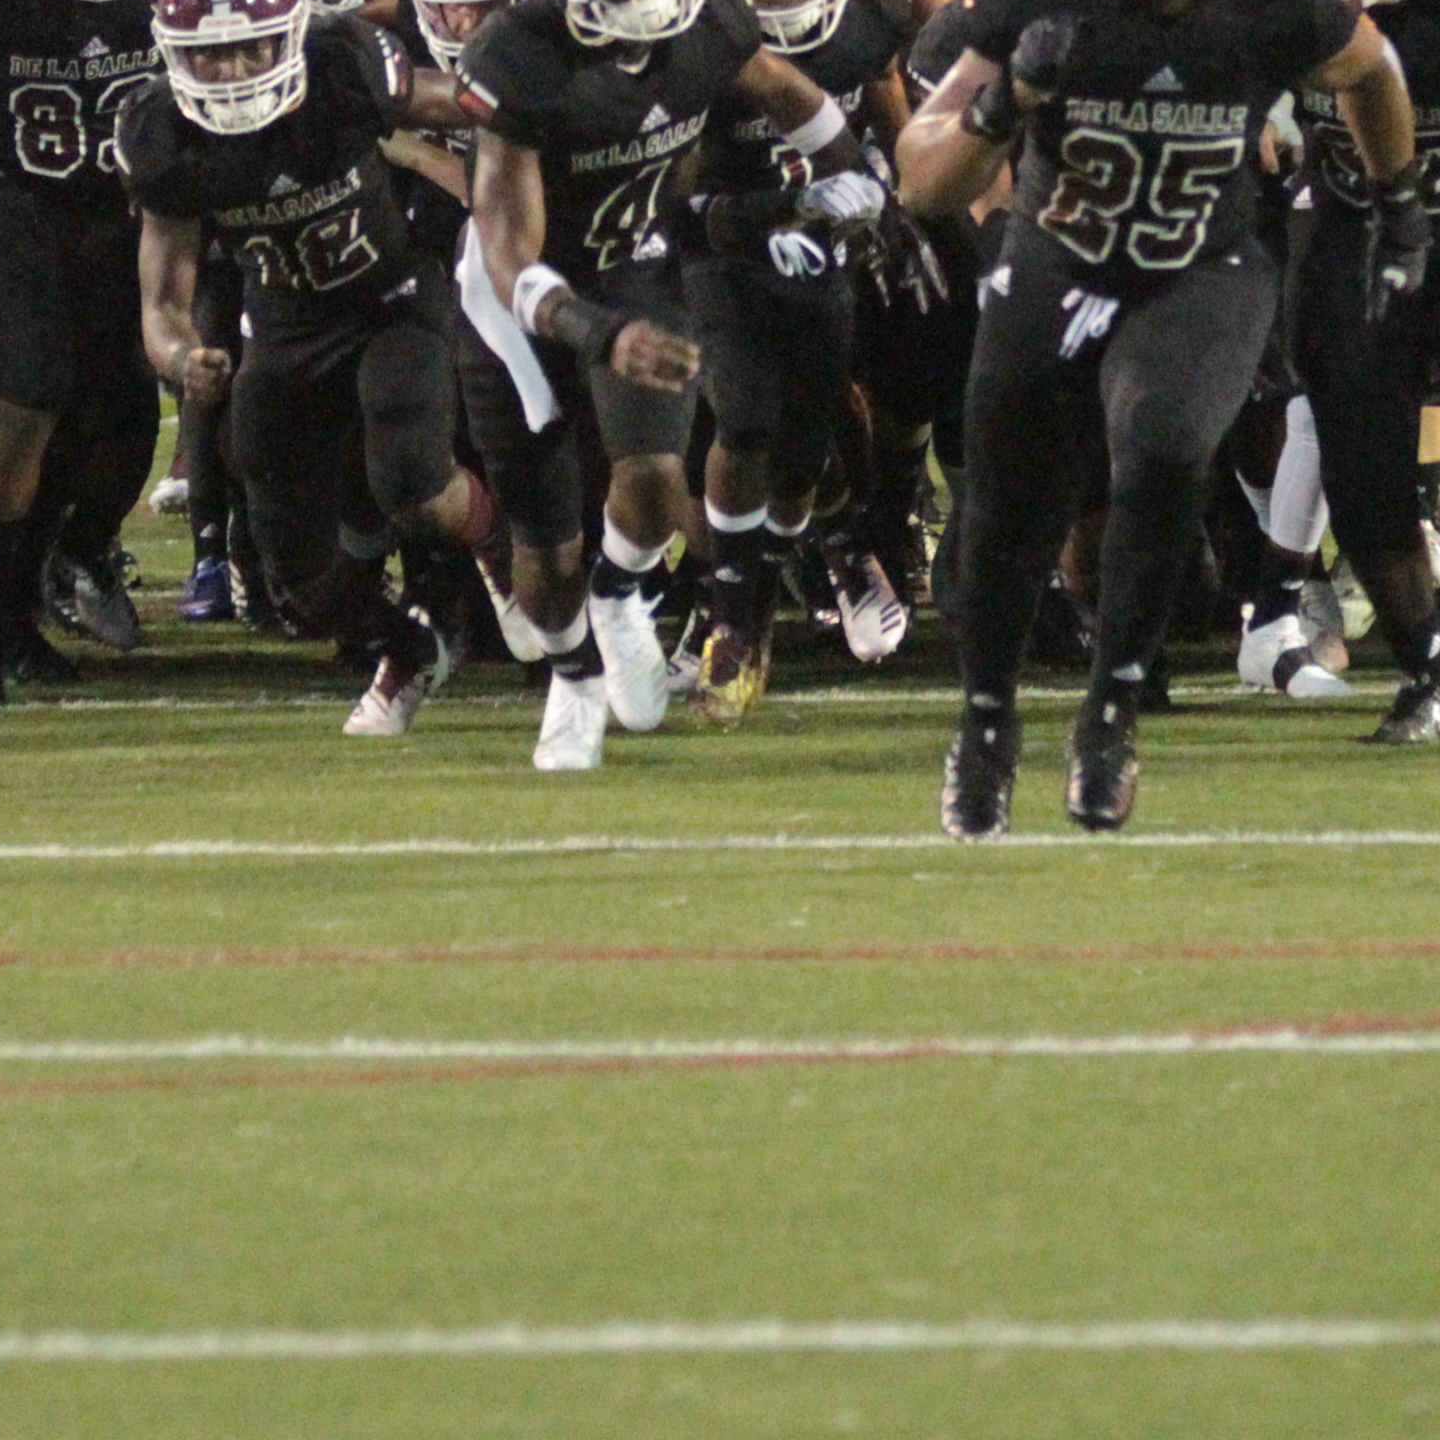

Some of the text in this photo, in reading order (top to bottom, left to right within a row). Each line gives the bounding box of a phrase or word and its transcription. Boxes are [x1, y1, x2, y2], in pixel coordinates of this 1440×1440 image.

[10, 56, 43, 79] DE
[47, 58, 81, 81] LA
[1106, 101, 1149, 133] LA
[1151, 102, 1249, 137] SALLE
[582, 157, 673, 272] 4
[1037, 127, 1246, 270] 25
